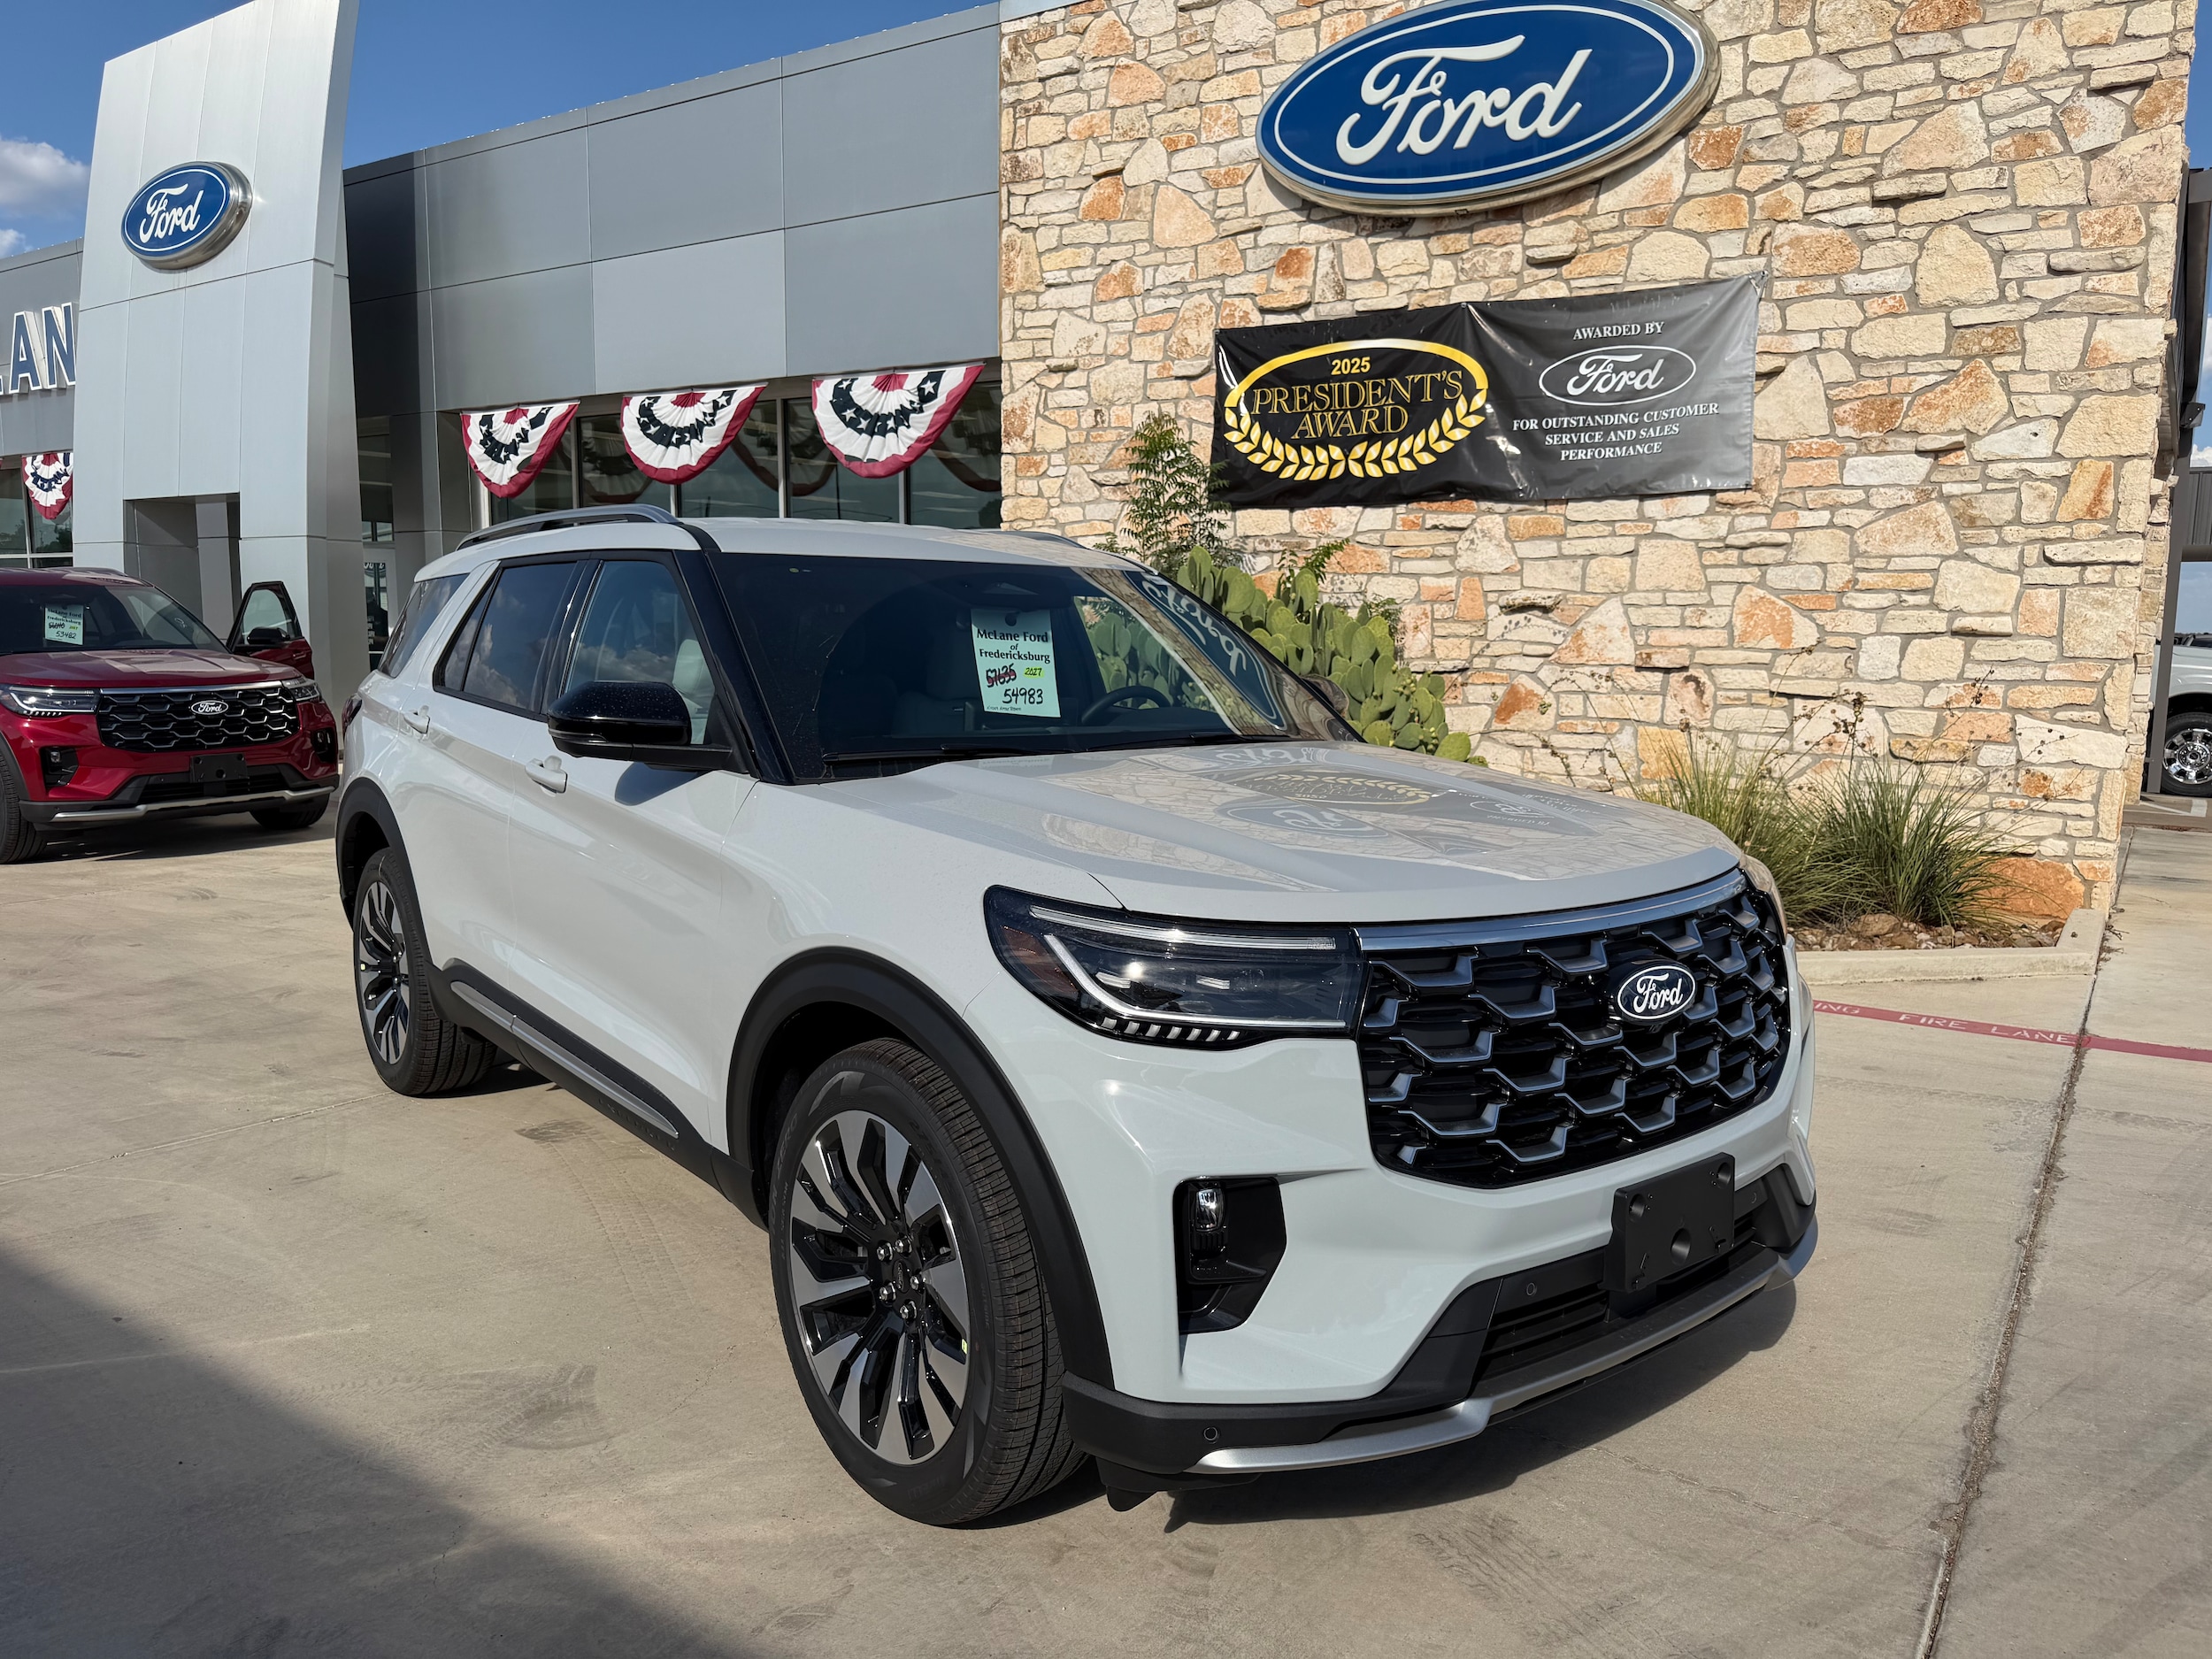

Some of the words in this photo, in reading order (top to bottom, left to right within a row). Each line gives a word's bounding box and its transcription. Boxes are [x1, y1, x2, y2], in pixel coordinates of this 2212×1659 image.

[1335, 35, 1594, 165] Ford
[139, 182, 204, 243] Ford
[1572, 324, 1641, 341] AWARDED
[1645, 321, 1665, 335] BY
[0, 302, 77, 395] AN
[1331, 356, 1371, 376] 2025
[1566, 353, 1664, 396] Ford
[1250, 370, 1463, 415] PRESIDENT'S
[1290, 404, 1409, 440] AWARD
[1512, 418, 1539, 431] FOR
[1541, 412, 1640, 430] OUTSTANDING
[1643, 403, 1719, 423] CUSTOMER
[1545, 431, 1604, 446] SERVICE
[1607, 428, 1635, 442] AND
[1639, 423, 1680, 440] SALES
[1560, 442, 1663, 461] PERFORMANCE
[977, 628, 1019, 641] McLane
[1023, 631, 1049, 643] Ford
[979, 649, 1051, 664] Fredericksburg
[197, 703, 223, 713] Ford
[1002, 687, 1043, 705] 54983
[1633, 972, 1684, 1013] Ford
[1814, 1002, 1861, 1014] ING
[1899, 1013, 1969, 1030] FIRE
[1991, 1025, 2076, 1045] LANE
